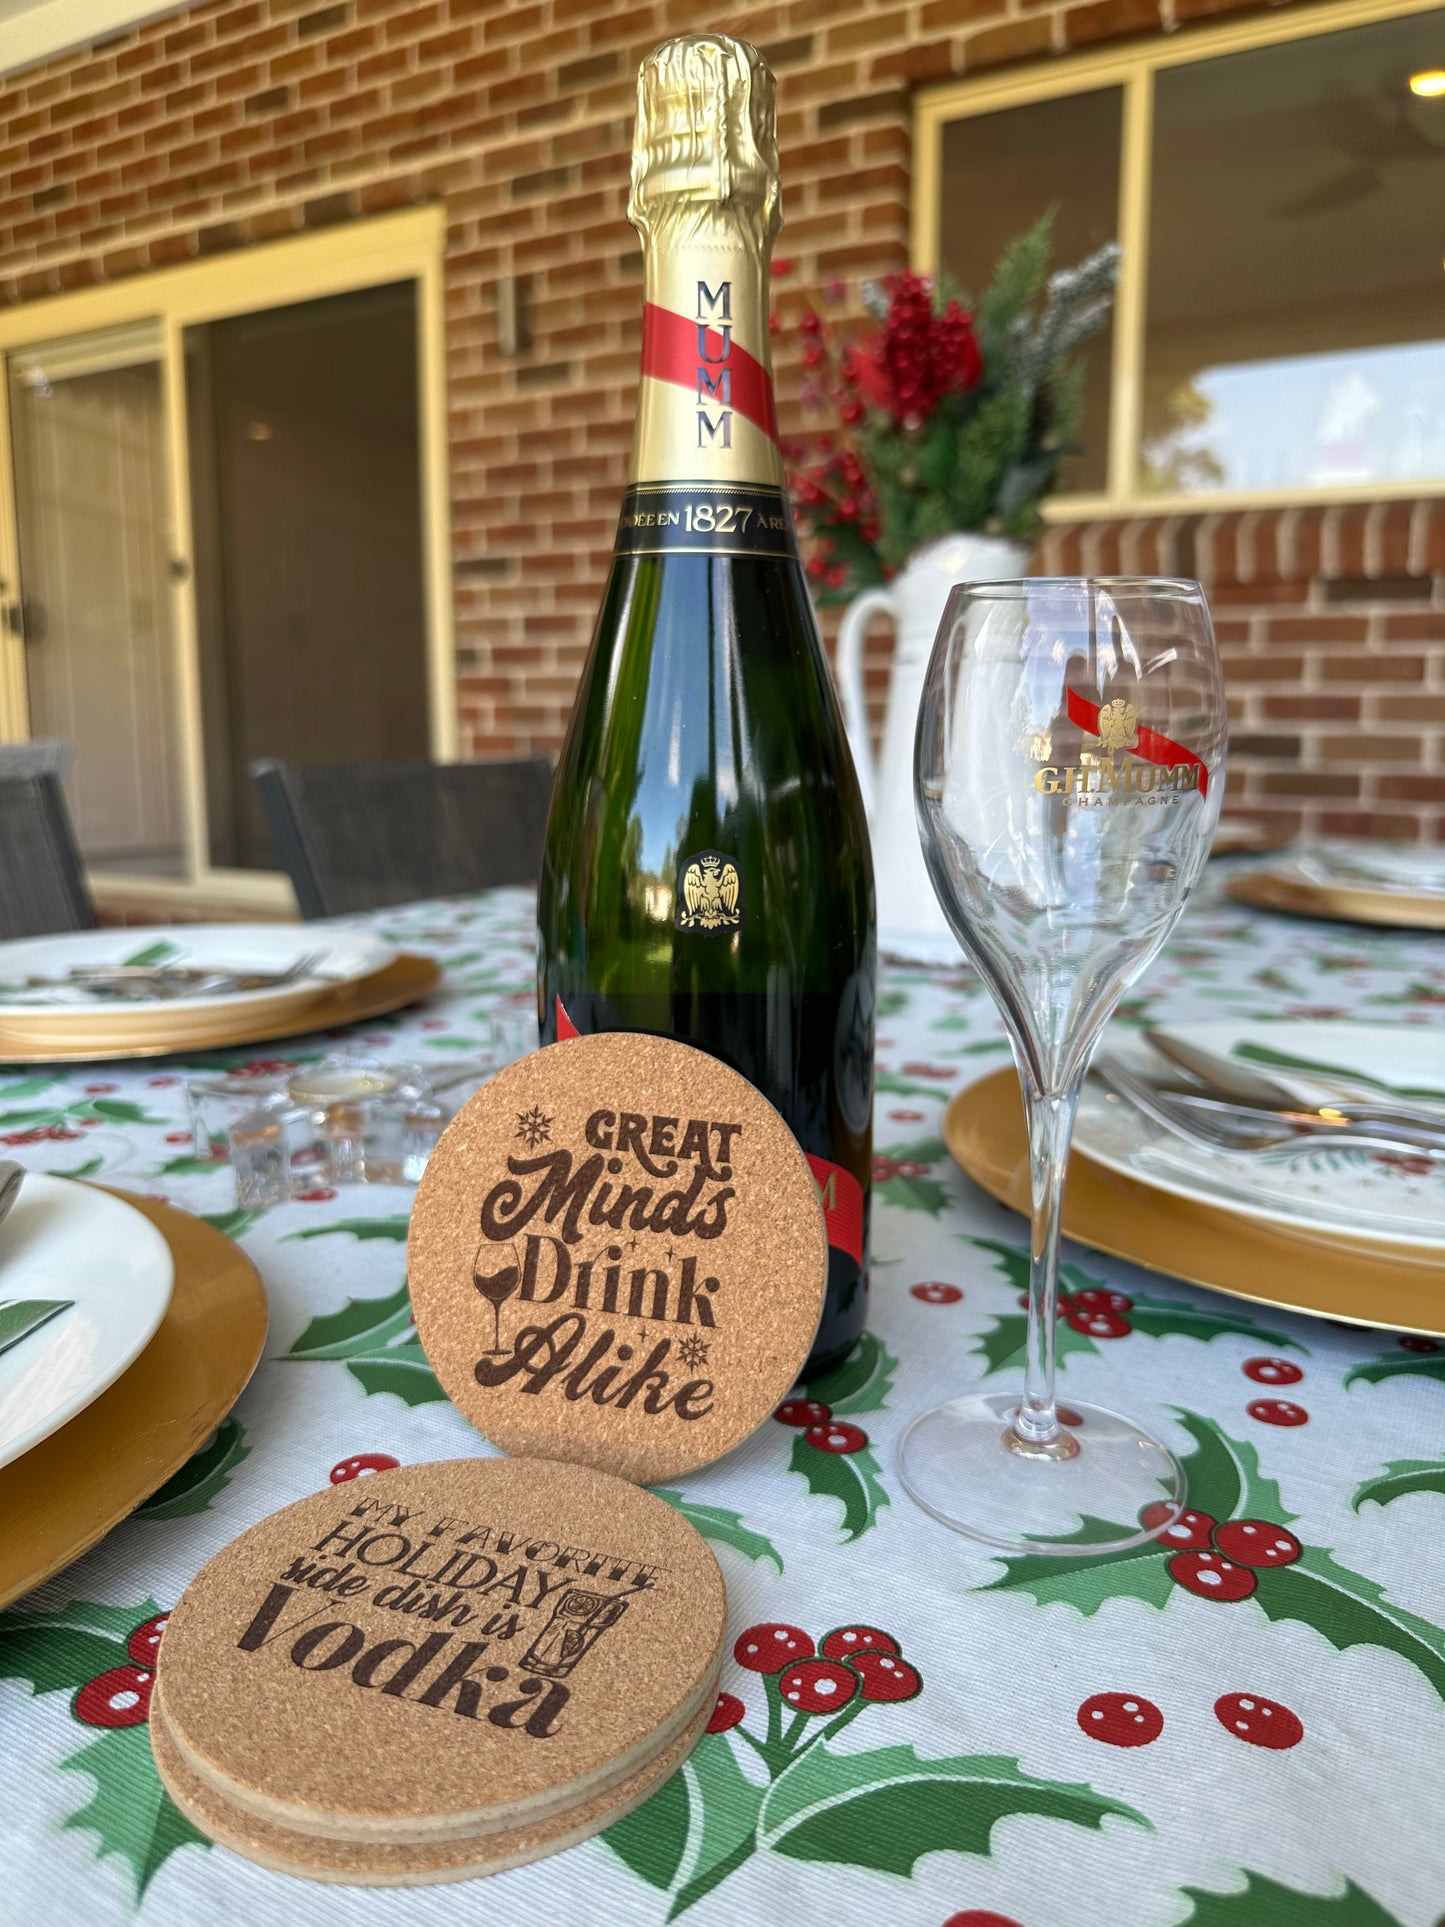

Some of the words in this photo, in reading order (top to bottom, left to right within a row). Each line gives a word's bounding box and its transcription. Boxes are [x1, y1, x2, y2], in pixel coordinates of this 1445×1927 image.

[696, 280, 733, 449] MUMM
[657, 511, 680, 526] EN
[684, 503, 753, 534] 1827
[1062, 795, 1180, 807] CHAMPAGNE
[585, 1109, 743, 1182] GREAT
[480, 1149, 736, 1244] Minds
[517, 1233, 721, 1329] Drink
[474, 1312, 715, 1420] Alike
[310, 1519, 578, 1610] HOLIDAY
[350, 1497, 425, 1527] MY
[427, 1516, 673, 1587] FAVORITE
[280, 1554, 372, 1599] side
[372, 1582, 479, 1628] dish
[481, 1604, 526, 1640] is
[236, 1580, 572, 1739] Vodka
